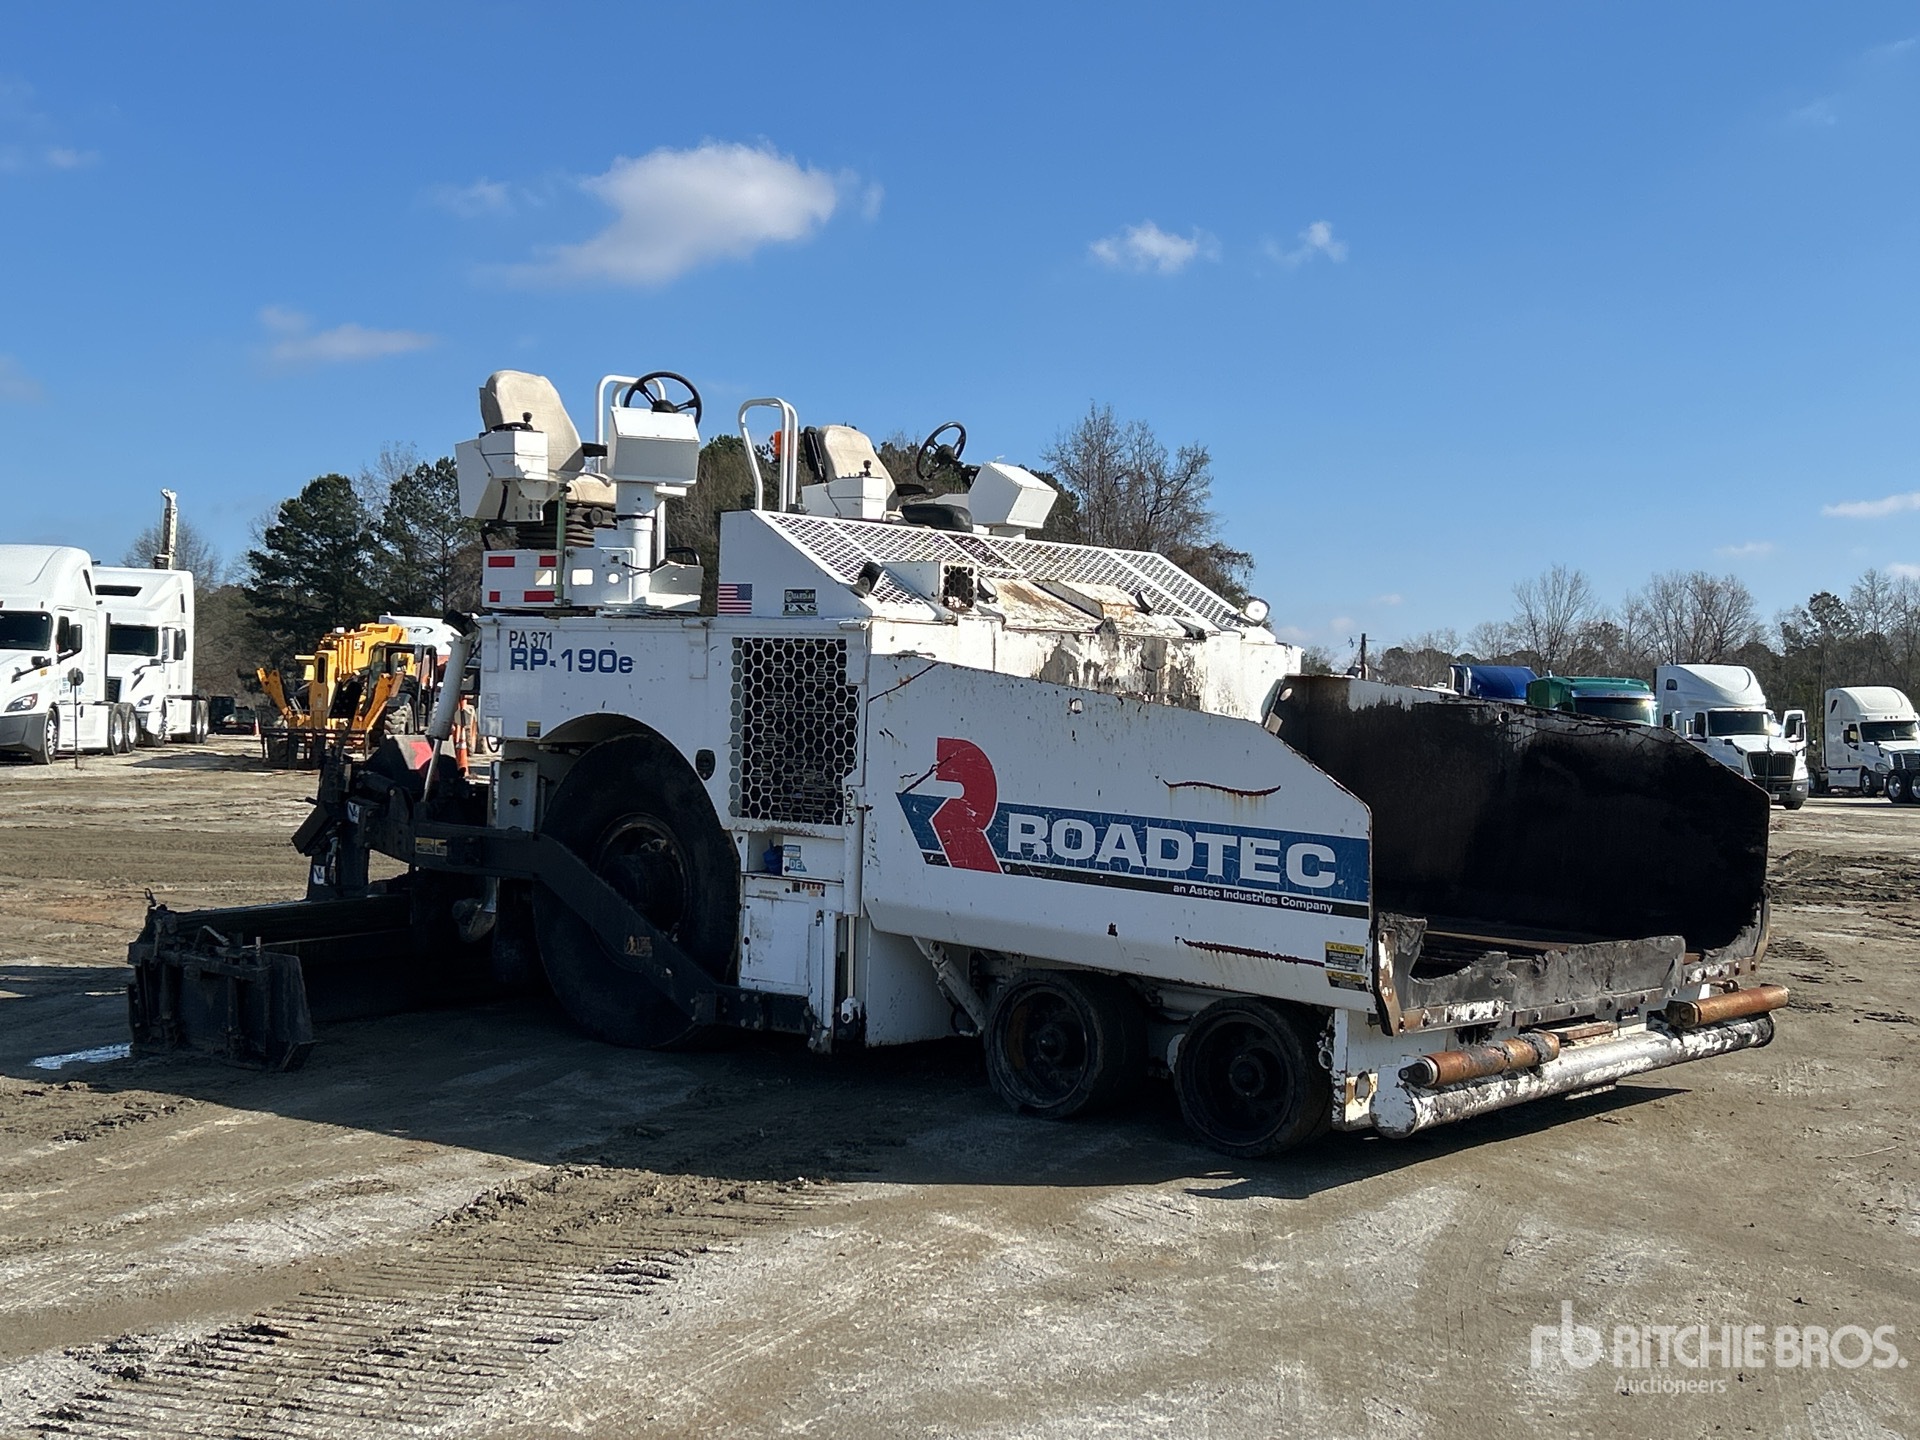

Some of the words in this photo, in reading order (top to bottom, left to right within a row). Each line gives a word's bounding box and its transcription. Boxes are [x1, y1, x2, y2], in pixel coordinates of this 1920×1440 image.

[510, 648, 633, 673] RP-190e
[1007, 813, 1336, 889] ROADTEC
[1173, 884, 1186, 894] an
[1189, 885, 1220, 898] Astec
[1223, 889, 1278, 905] Industries
[1281, 896, 1333, 914] Company
